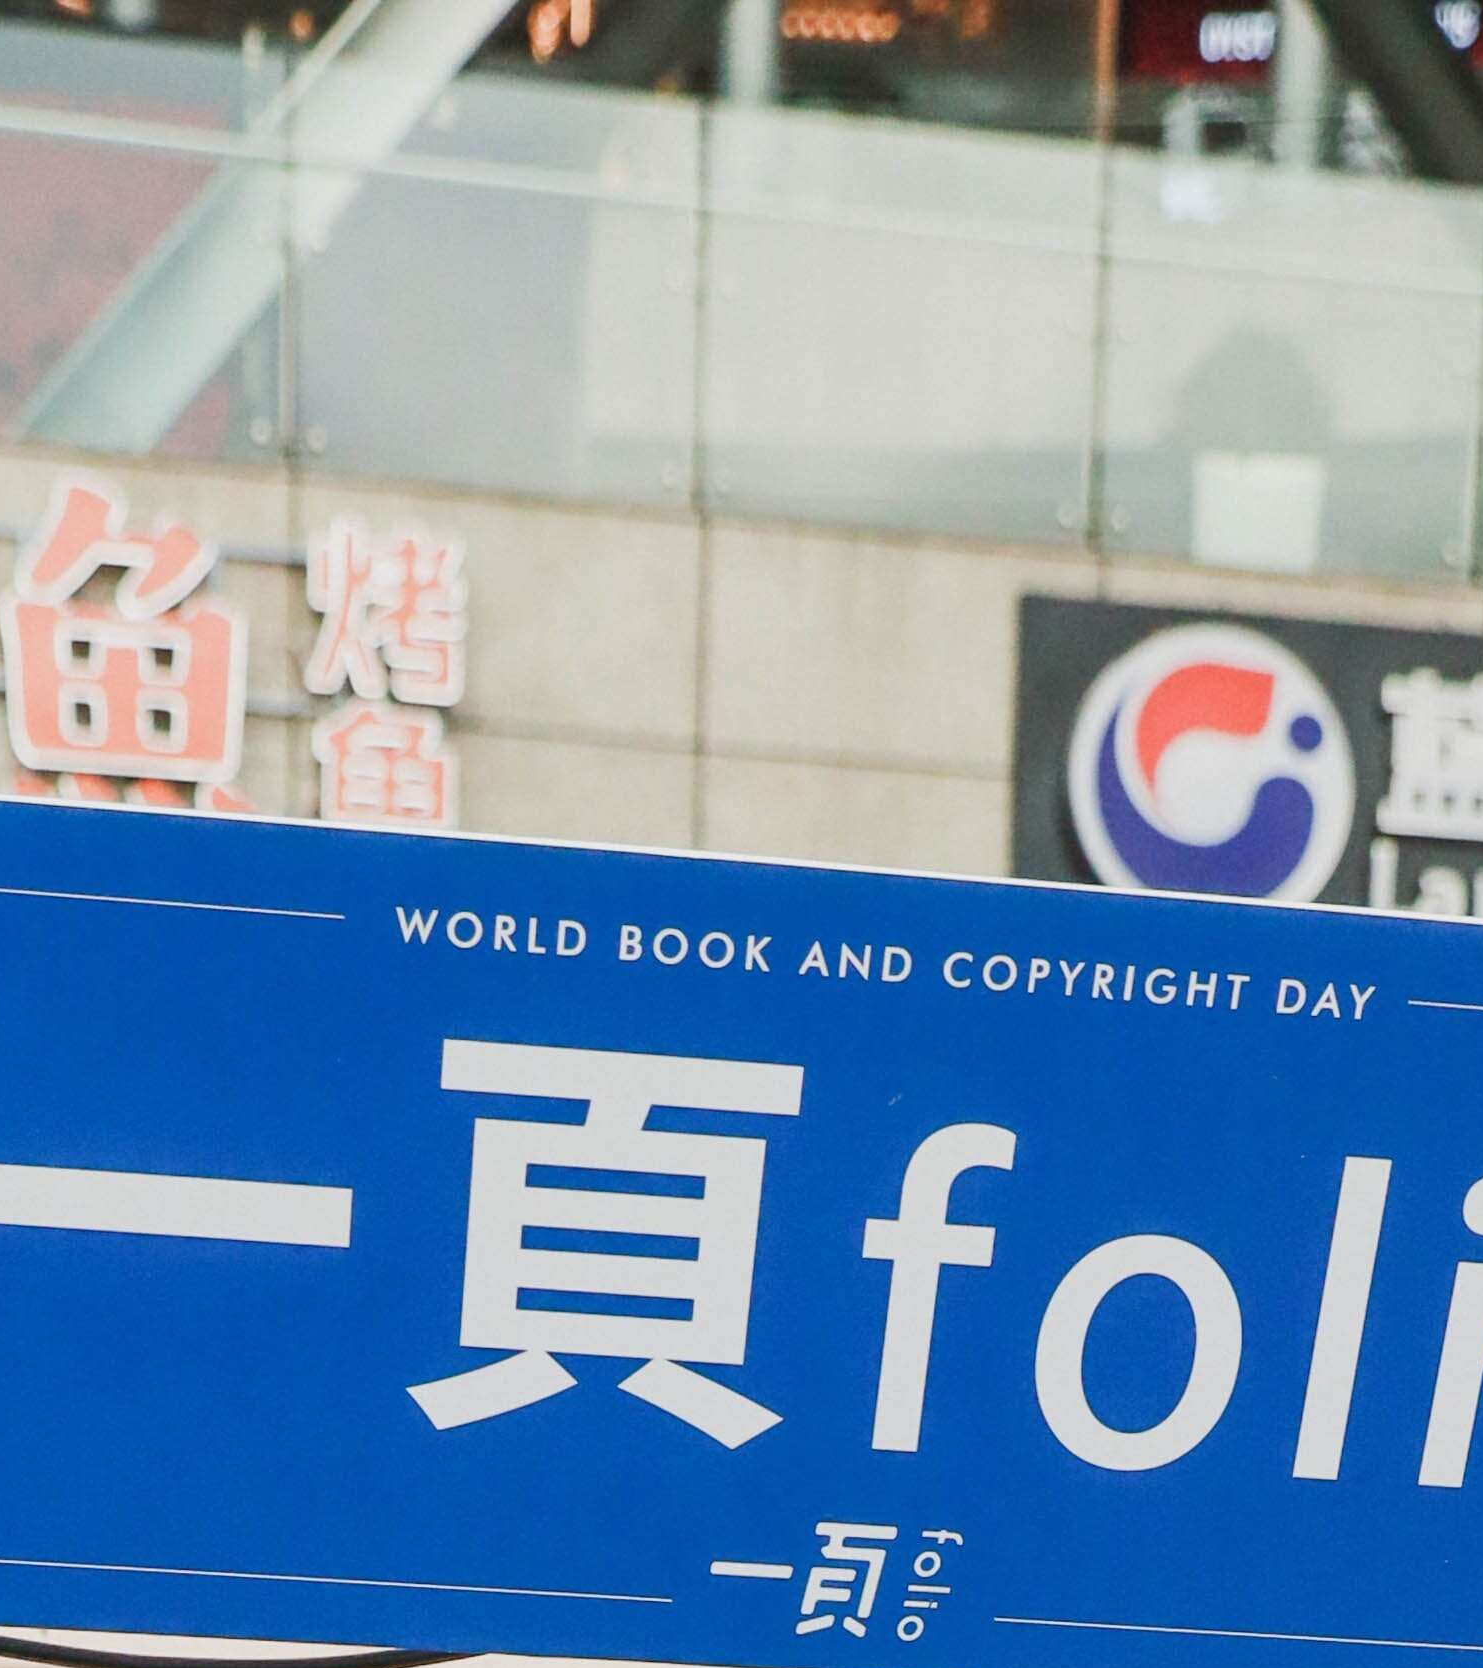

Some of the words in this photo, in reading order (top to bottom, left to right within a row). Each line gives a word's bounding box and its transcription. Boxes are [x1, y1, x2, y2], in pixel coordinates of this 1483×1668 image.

[396, 906, 588, 958] WORLD
[619, 926, 773, 974] BOOK
[798, 943, 914, 985] AND
[942, 951, 1250, 1013] COPYRIGHT
[1276, 980, 1376, 1022] DAY
